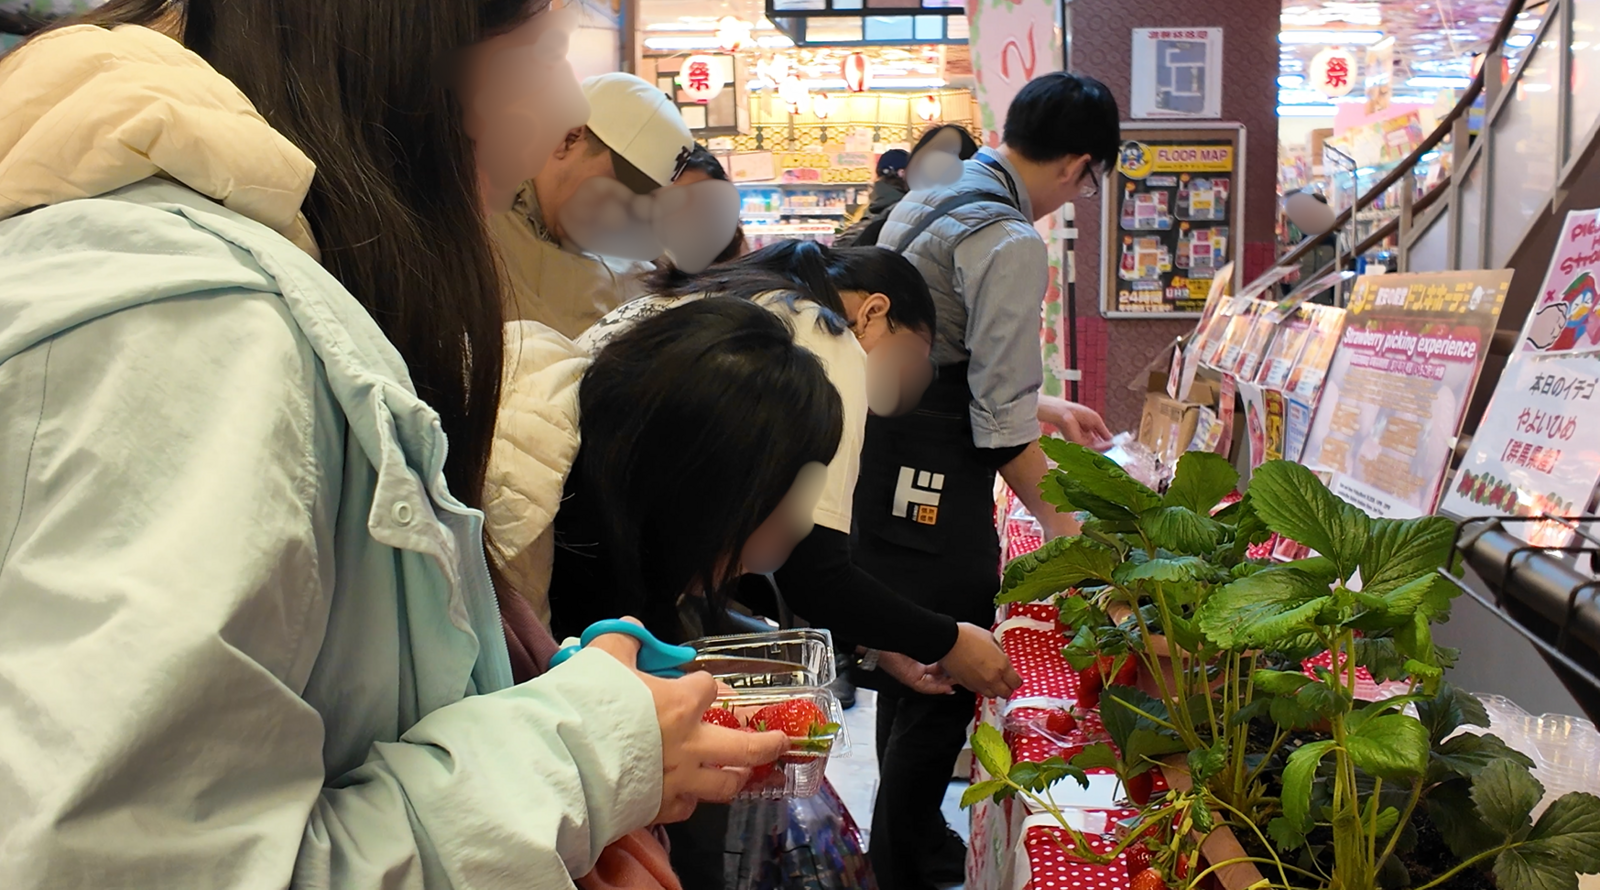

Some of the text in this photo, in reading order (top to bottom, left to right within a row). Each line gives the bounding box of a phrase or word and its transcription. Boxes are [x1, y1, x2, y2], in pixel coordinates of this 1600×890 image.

[688, 61, 710, 91] 祭
[1325, 57, 1348, 87] 祭
[1158, 149, 1228, 162] FLOOR MAP
[1343, 326, 1477, 358] Strawberry picking experience
[1529, 372, 1599, 400] 本日のイチゴ
[1516, 407, 1578, 441] やよいひめ
